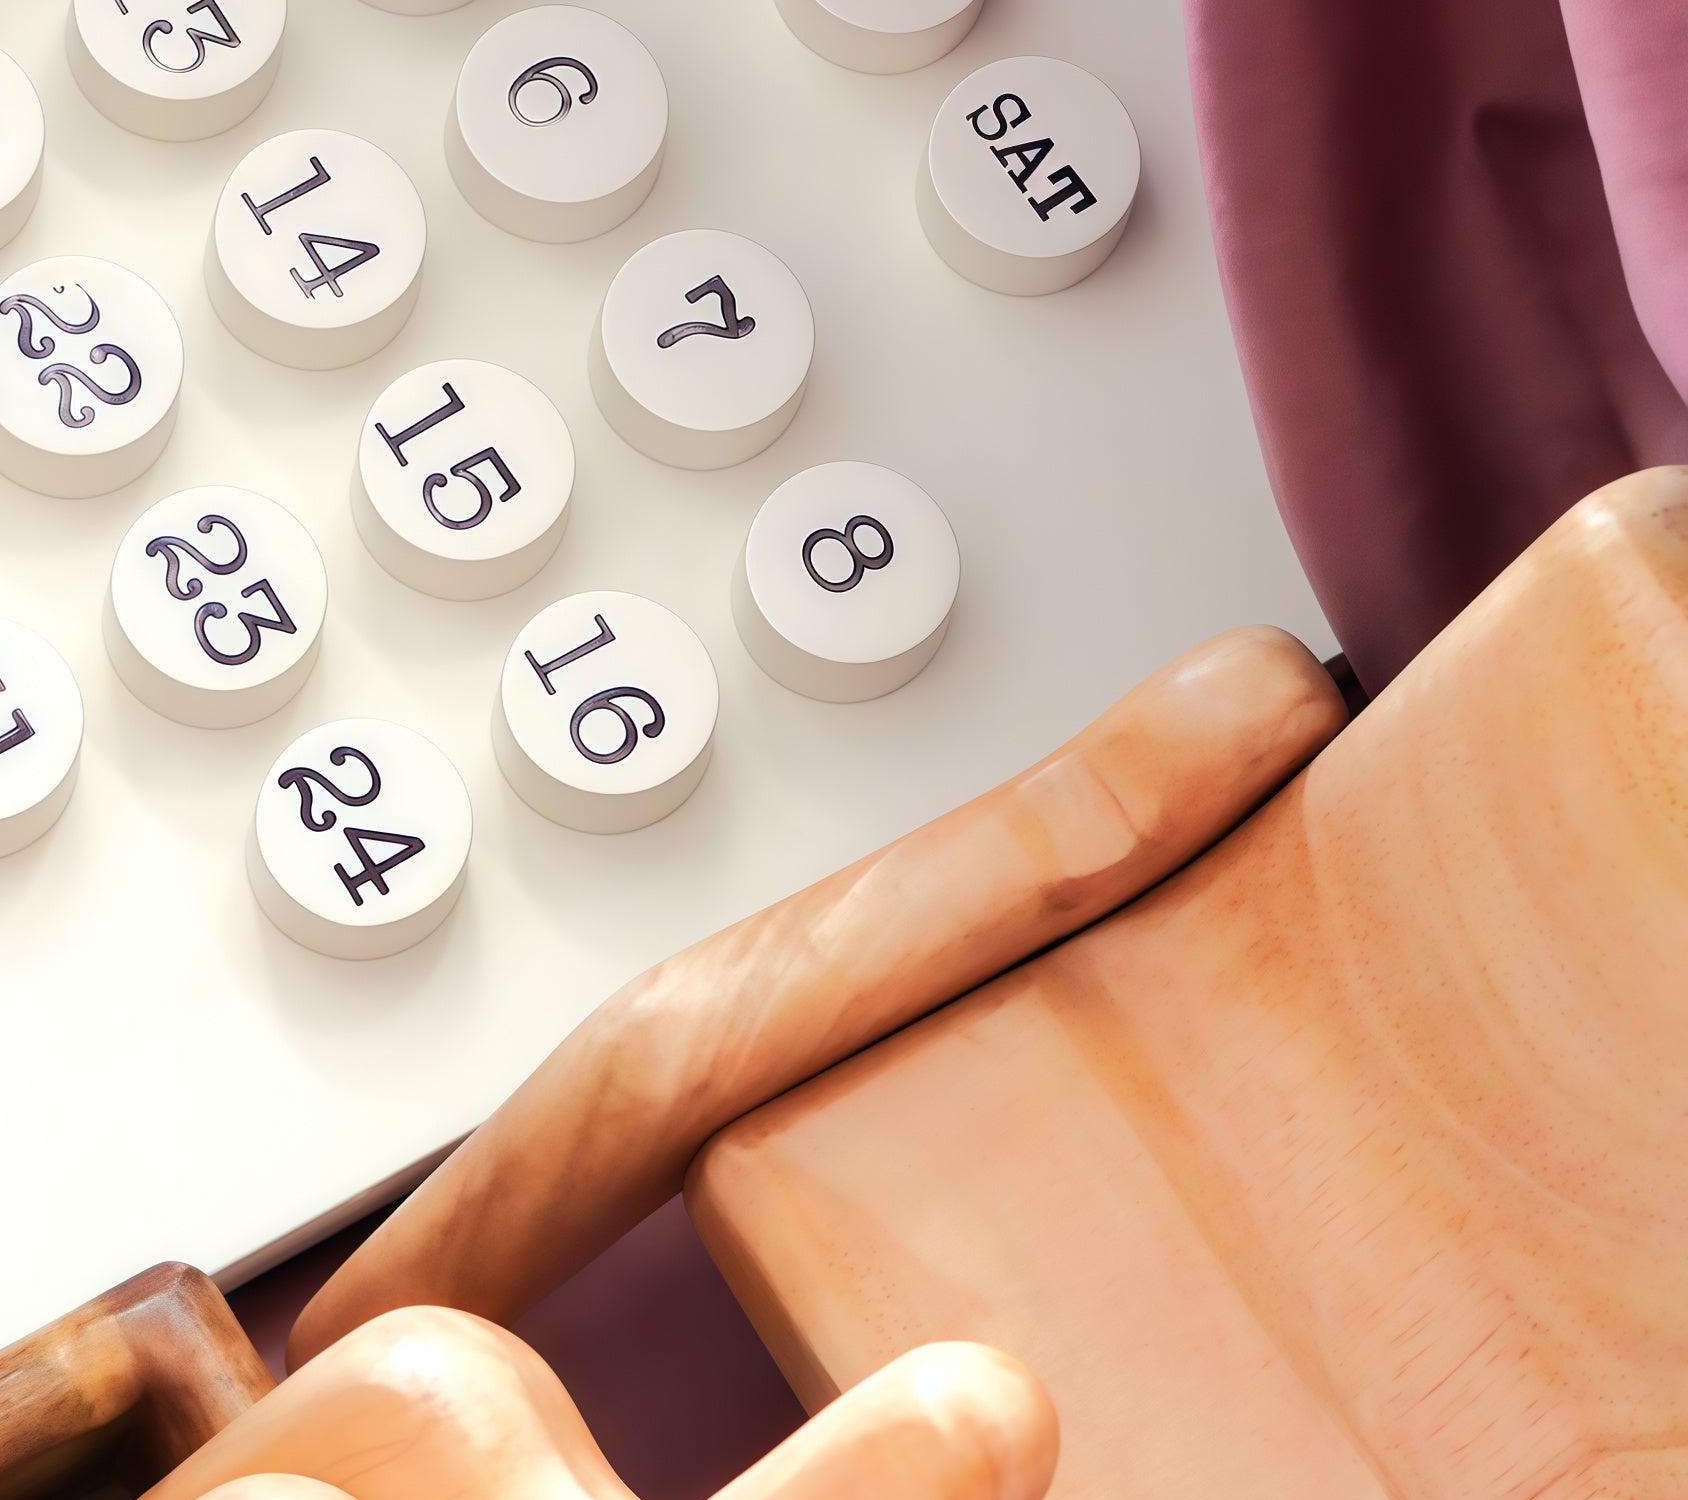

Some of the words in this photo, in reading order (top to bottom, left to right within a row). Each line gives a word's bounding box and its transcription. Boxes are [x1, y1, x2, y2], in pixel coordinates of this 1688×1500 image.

[507, 56, 599, 128] 6
[965, 92, 1098, 223] SAT
[240, 155, 381, 300] 14
[656, 274, 758, 350] 7
[374, 381, 522, 531] 15
[144, 513, 298, 667] 23
[801, 514, 895, 594] 8
[523, 613, 666, 765] 16
[277, 745, 427, 907] 24
